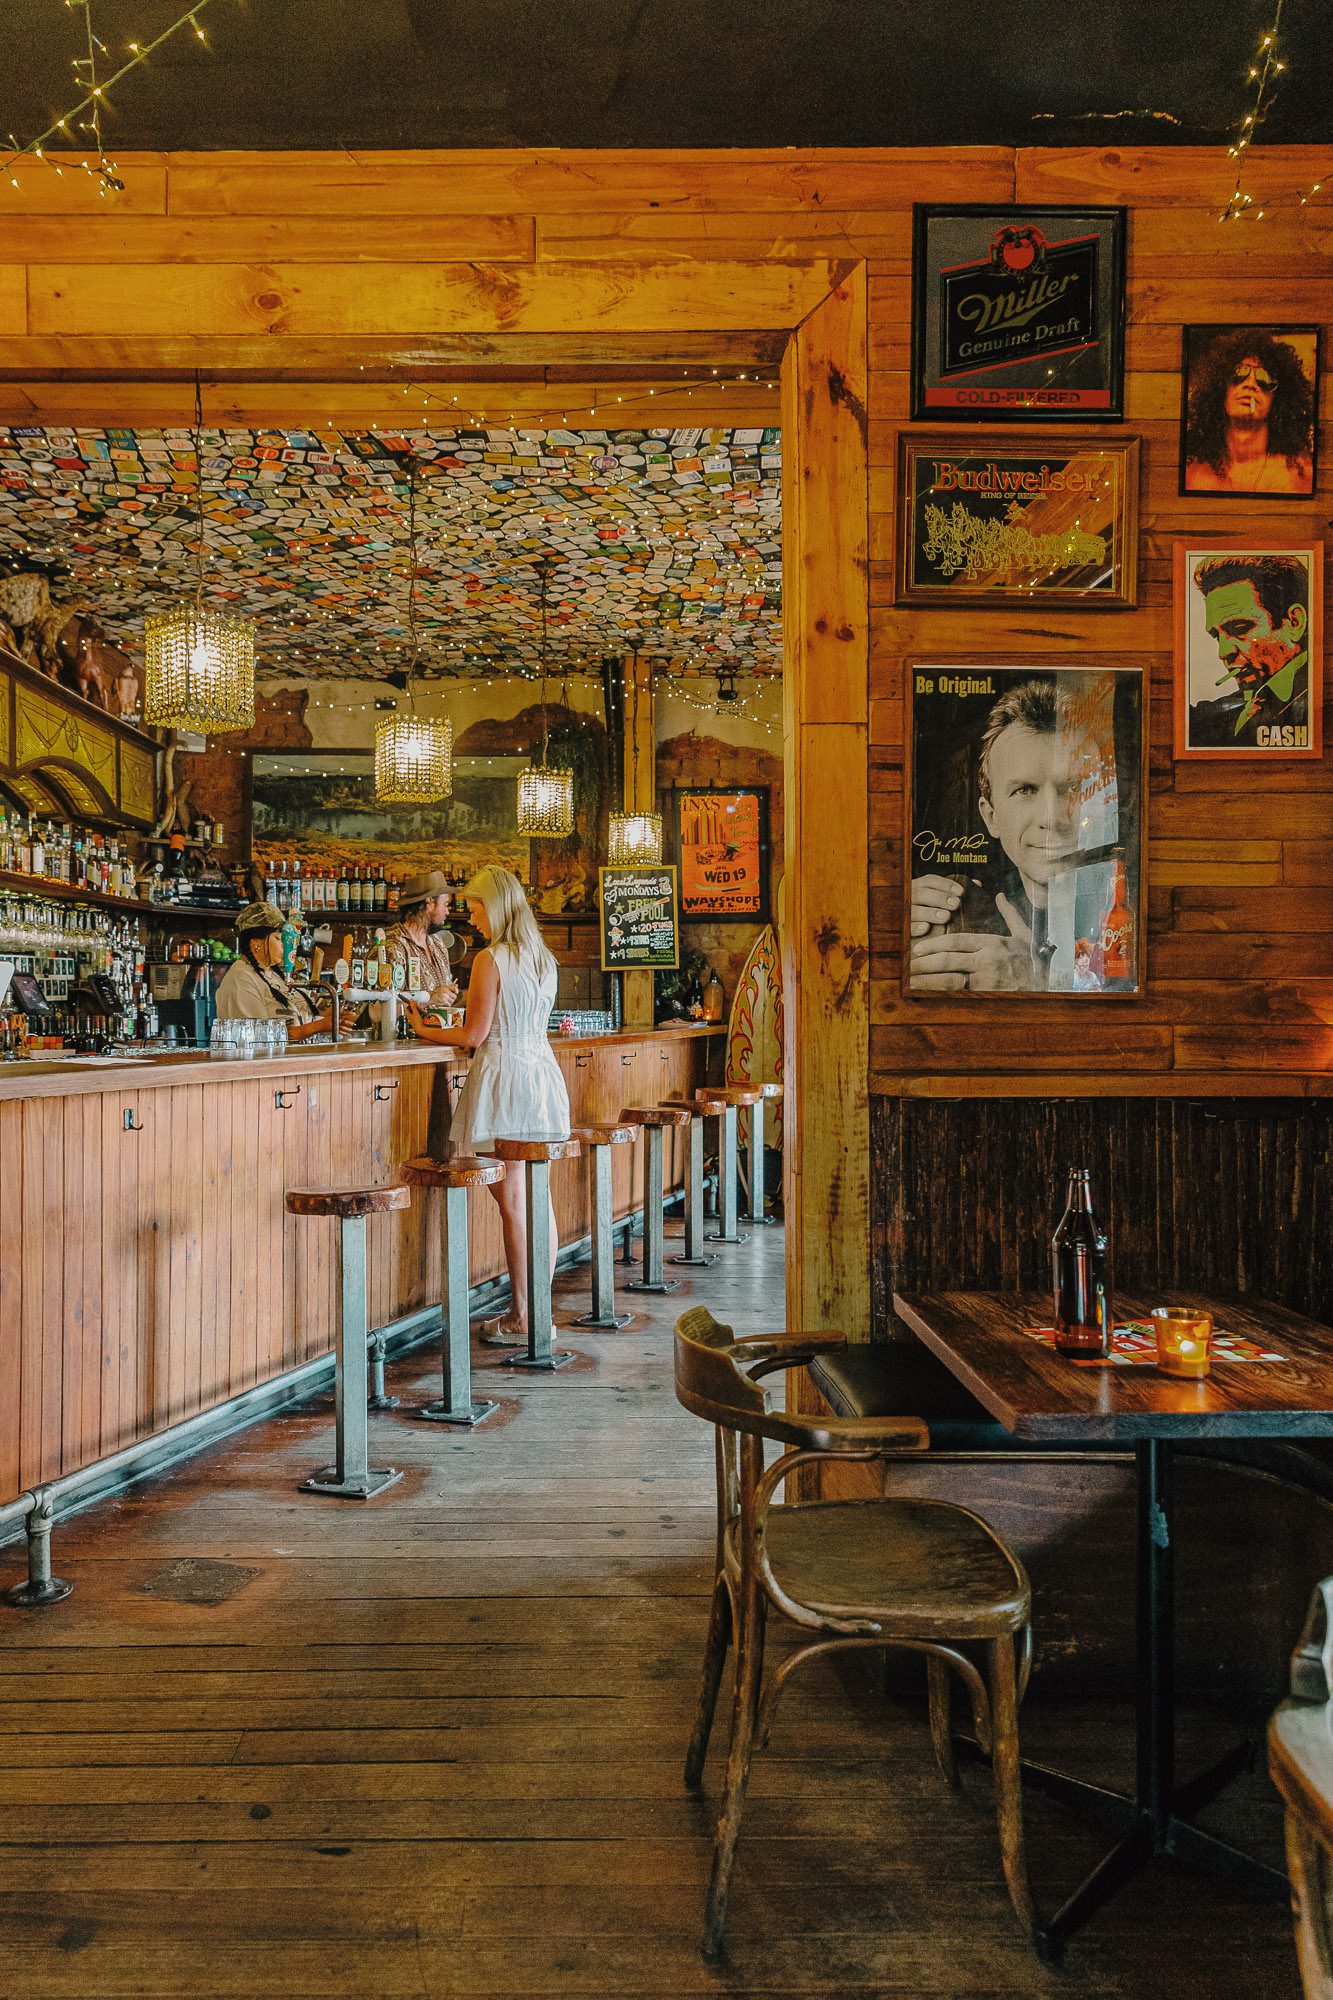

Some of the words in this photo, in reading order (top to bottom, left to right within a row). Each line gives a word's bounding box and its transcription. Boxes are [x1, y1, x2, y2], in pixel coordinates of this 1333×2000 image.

[956, 273, 1080, 334] Miller
[958, 330, 1031, 357] Genuine
[1034, 317, 1081, 341] Draft
[956, 391, 1081, 404] COLD-FILTERED
[931, 461, 1101, 491] Budweiser
[916, 676, 934, 694] Be
[938, 676, 996, 698] Original.
[1256, 725, 1308, 747] CASH
[681, 798, 720, 811] INXS
[936, 852, 950, 863] Joe
[952, 852, 988, 863] Montana
[704, 870, 730, 883] WED
[732, 868, 746, 881] 19
[618, 886, 660, 897] MONDAYS
[684, 895, 760, 909] WAUCHOPE
[640, 903, 670, 921] POOL
[1101, 922, 1133, 952] Coors
